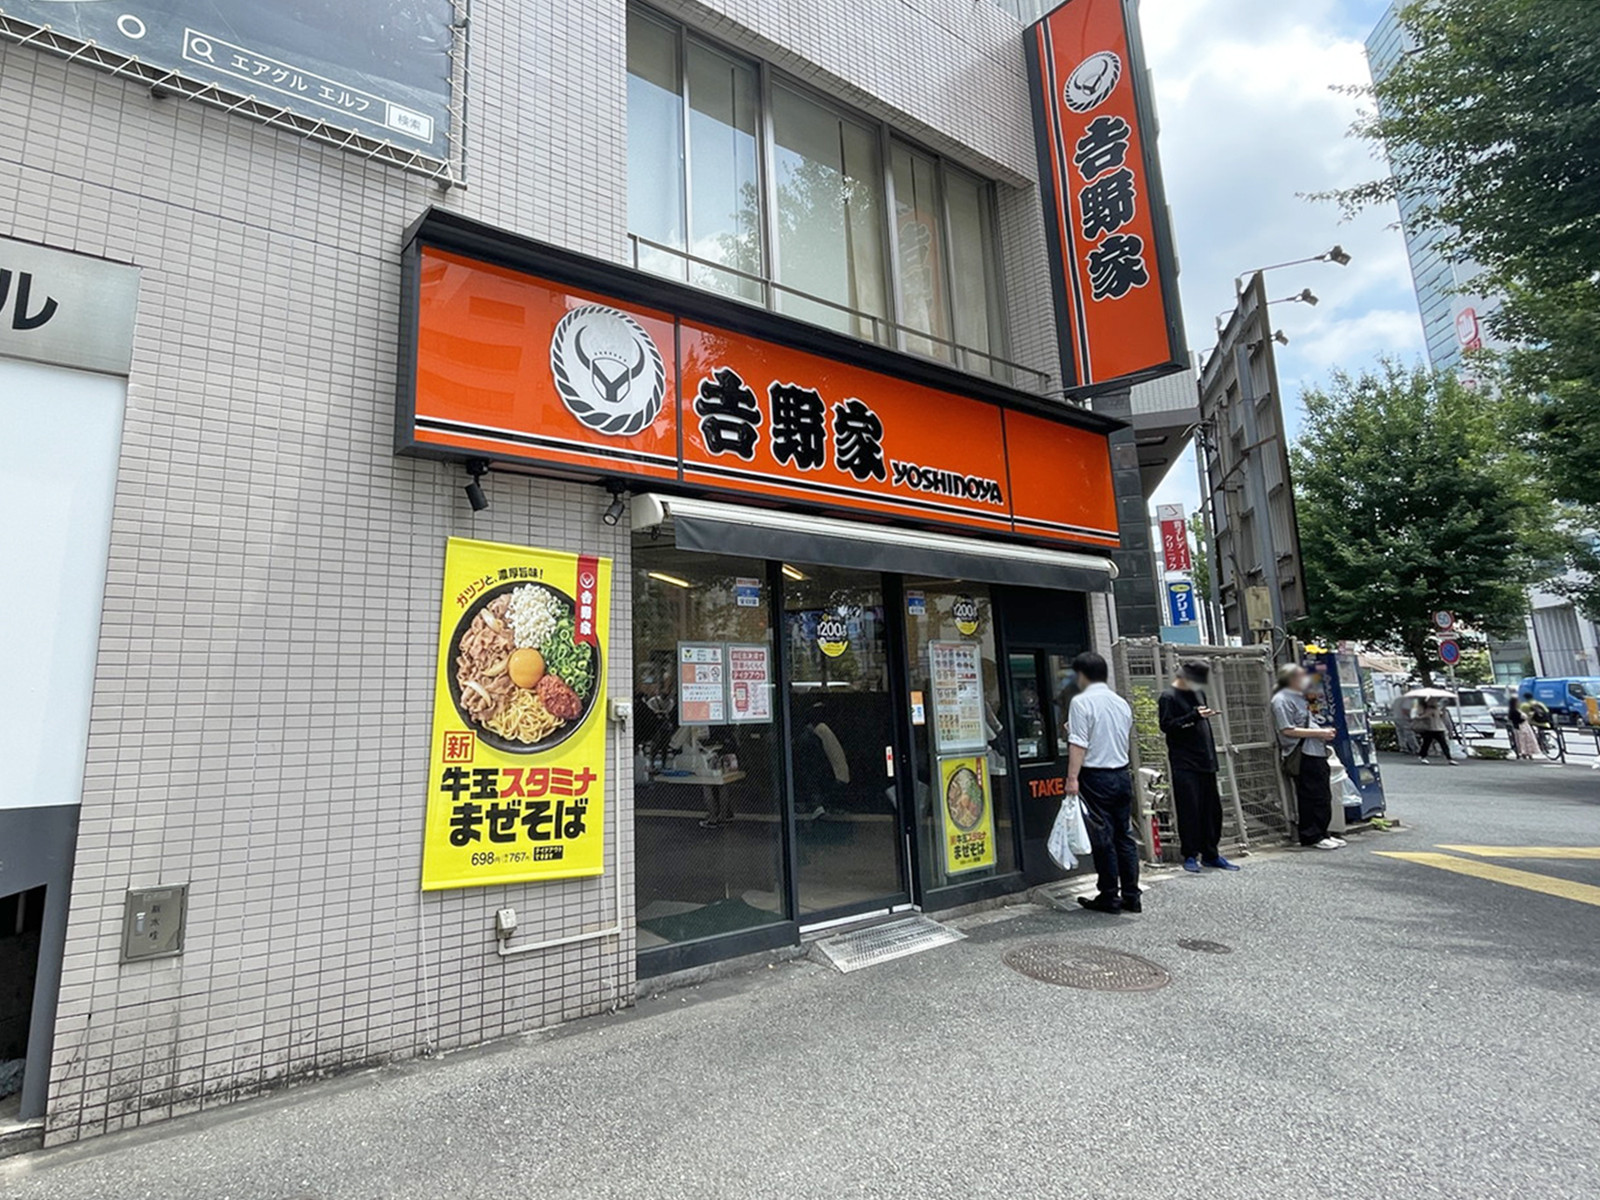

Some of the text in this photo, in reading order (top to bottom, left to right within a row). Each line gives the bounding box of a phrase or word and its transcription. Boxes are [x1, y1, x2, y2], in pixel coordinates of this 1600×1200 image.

[230, 53, 371, 113] エアグル エルフ
[889, 459, 1004, 507] YOSHINOYA
[446, 735, 471, 760] 新
[441, 766, 597, 801] 牛玉スタミナ
[1028, 778, 1065, 798] TAKE
[449, 799, 588, 847] まぜそば
